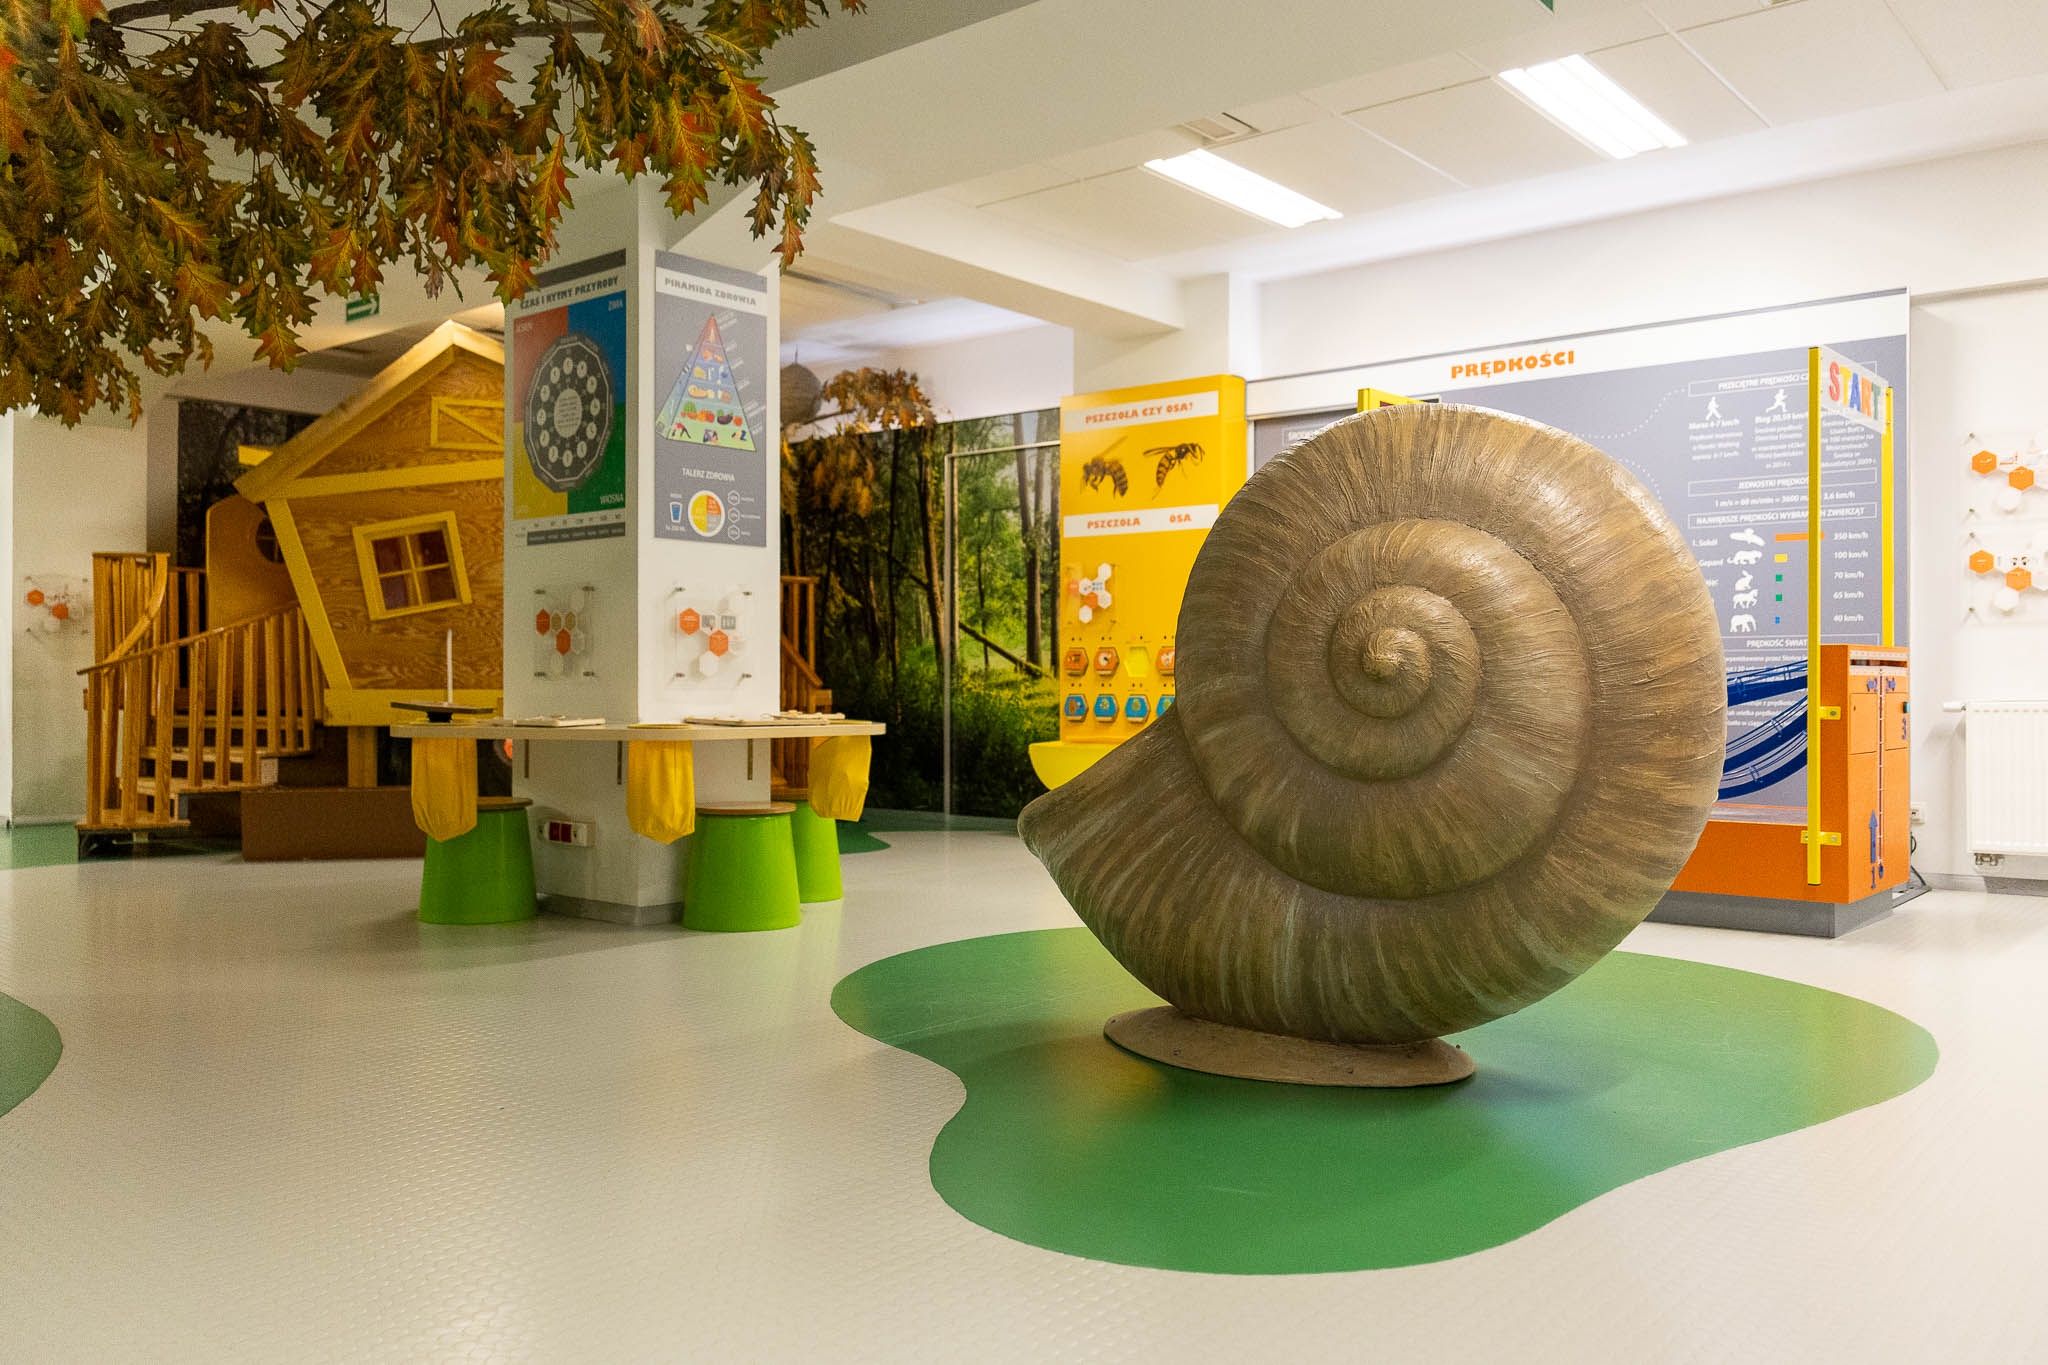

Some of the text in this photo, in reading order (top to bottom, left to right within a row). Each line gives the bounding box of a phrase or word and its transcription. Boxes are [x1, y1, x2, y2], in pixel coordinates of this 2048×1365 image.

[545, 290, 573, 303] RYTMY
[575, 276, 618, 296] PRZYRODY
[665, 277, 757, 305] PIRAMIDA ZDROWIA
[1451, 350, 1575, 379] PRĘDKOŚCI
[1829, 362, 1881, 421] START
[1085, 410, 1138, 424] PSZCZOŁA
[1142, 406, 1163, 417] CZY
[682, 467, 705, 479] TALERZ
[1088, 518, 1140, 529] PSZCZOŁA
[1169, 514, 1192, 523] OSA
[1848, 531, 1869, 540] km/h
[1834, 551, 1847, 559] 100
[1848, 550, 1869, 558] km/h
[1834, 571, 1843, 579] 70
[1844, 570, 1864, 579] km/h
[1844, 590, 1864, 599] km/h
[1844, 613, 1864, 621] km/h
